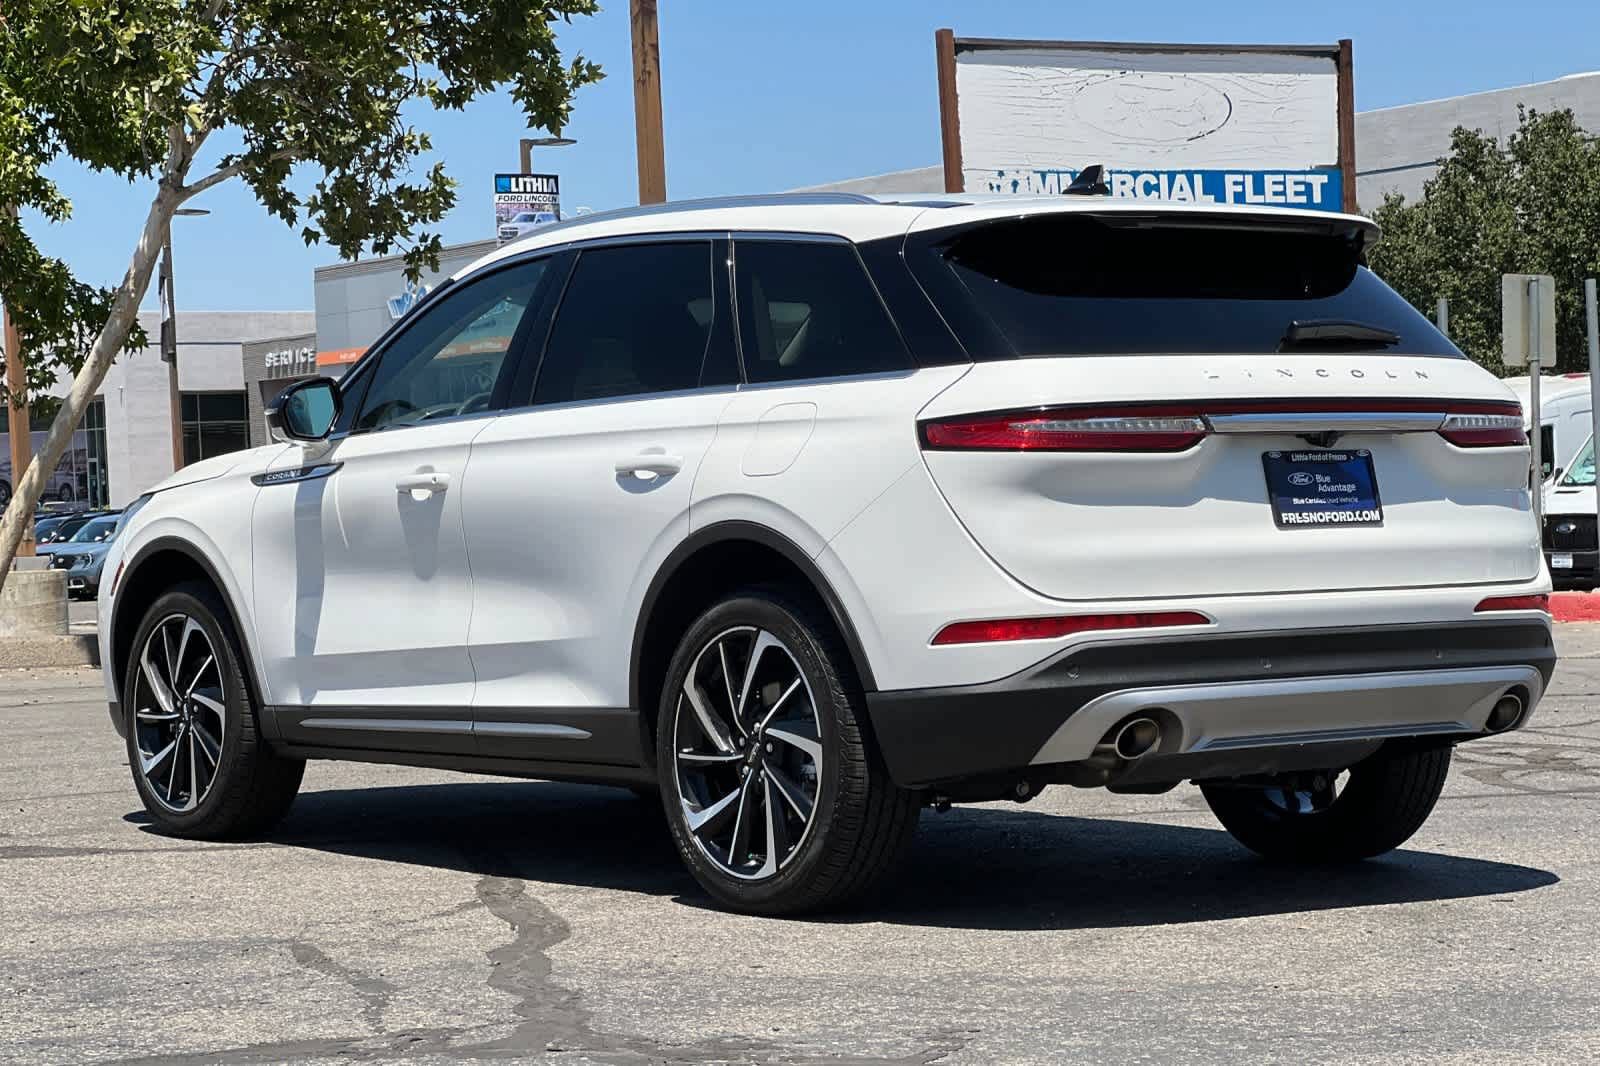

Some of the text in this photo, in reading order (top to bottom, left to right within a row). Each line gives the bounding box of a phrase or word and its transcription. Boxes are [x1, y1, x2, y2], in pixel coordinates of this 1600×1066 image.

[511, 177, 557, 192] LITHIA
[1225, 174, 1328, 204] FLEET
[265, 347, 316, 367] SERVICE
[1290, 473, 1311, 485] Ford
[1315, 473, 1331, 483] Blue
[1318, 483, 1357, 493] Advantage
[1281, 510, 1381, 524] FRESNOFORD.COM
